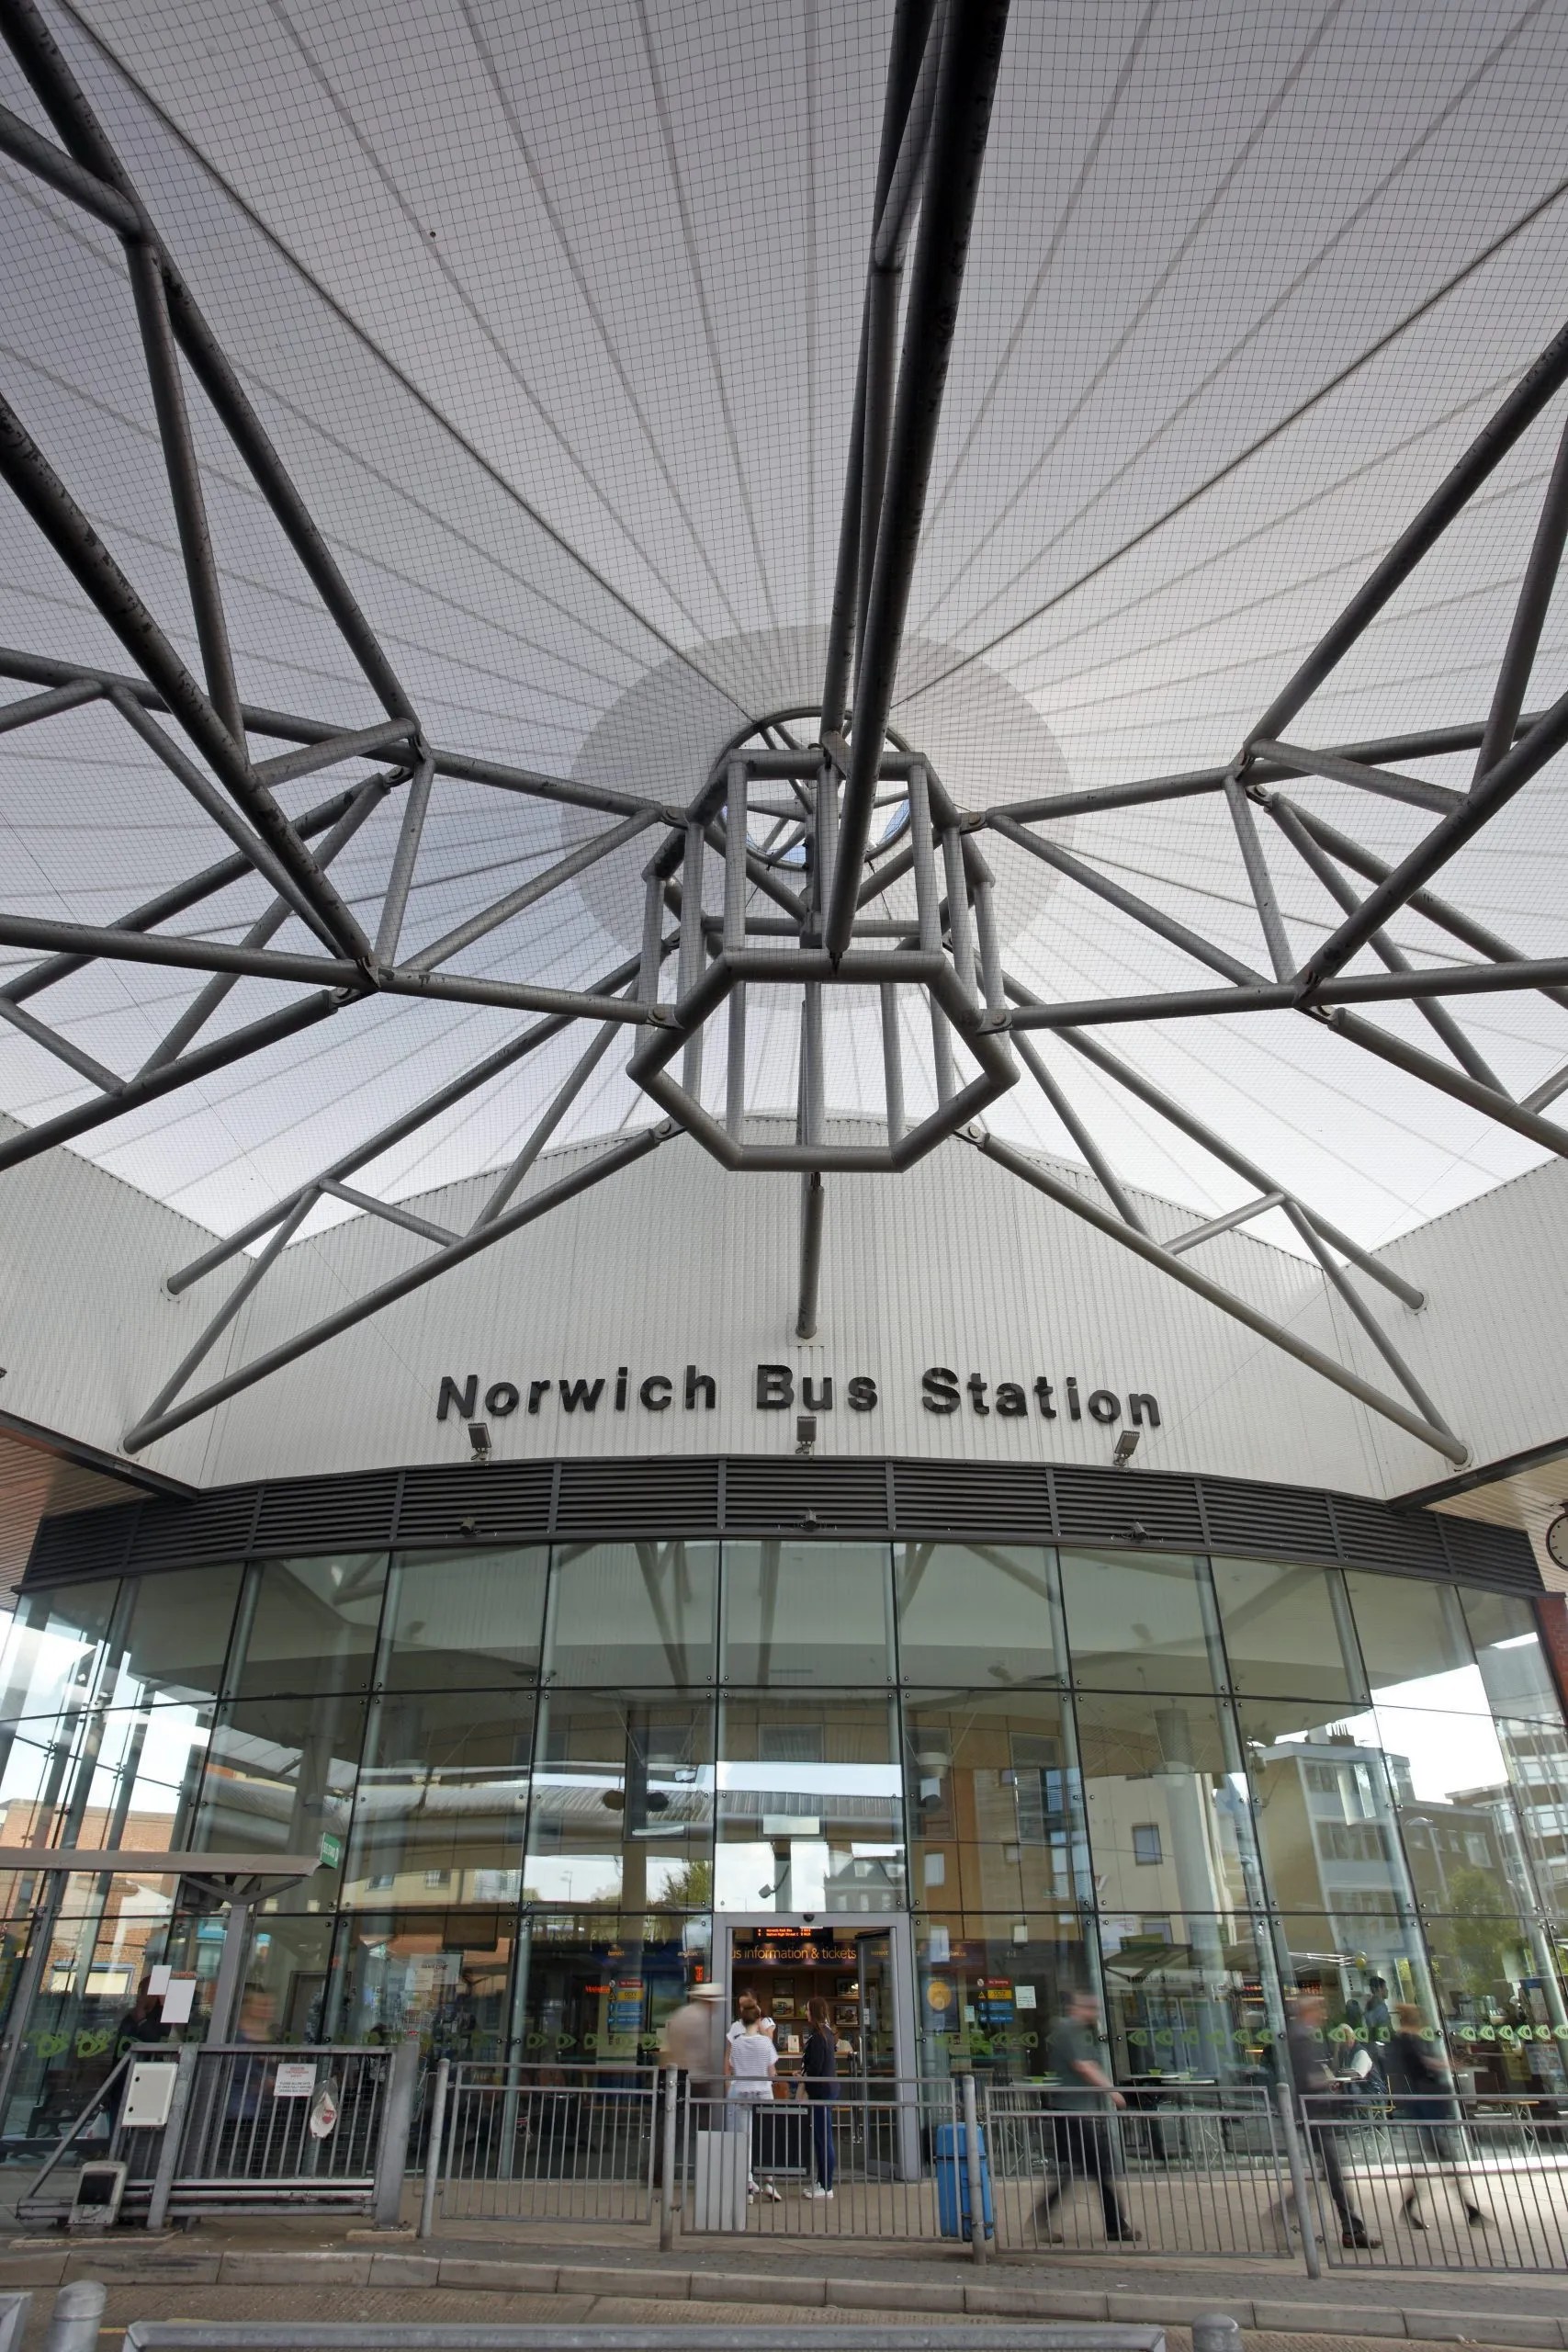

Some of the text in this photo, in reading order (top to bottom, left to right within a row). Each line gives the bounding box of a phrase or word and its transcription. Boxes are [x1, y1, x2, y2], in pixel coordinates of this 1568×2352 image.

[436, 1363, 1161, 1427] Norwich Bus Station
[744, 1945, 808, 1960] information
[810, 1948, 819, 1960] &
[822, 1946, 857, 1960] tickets
